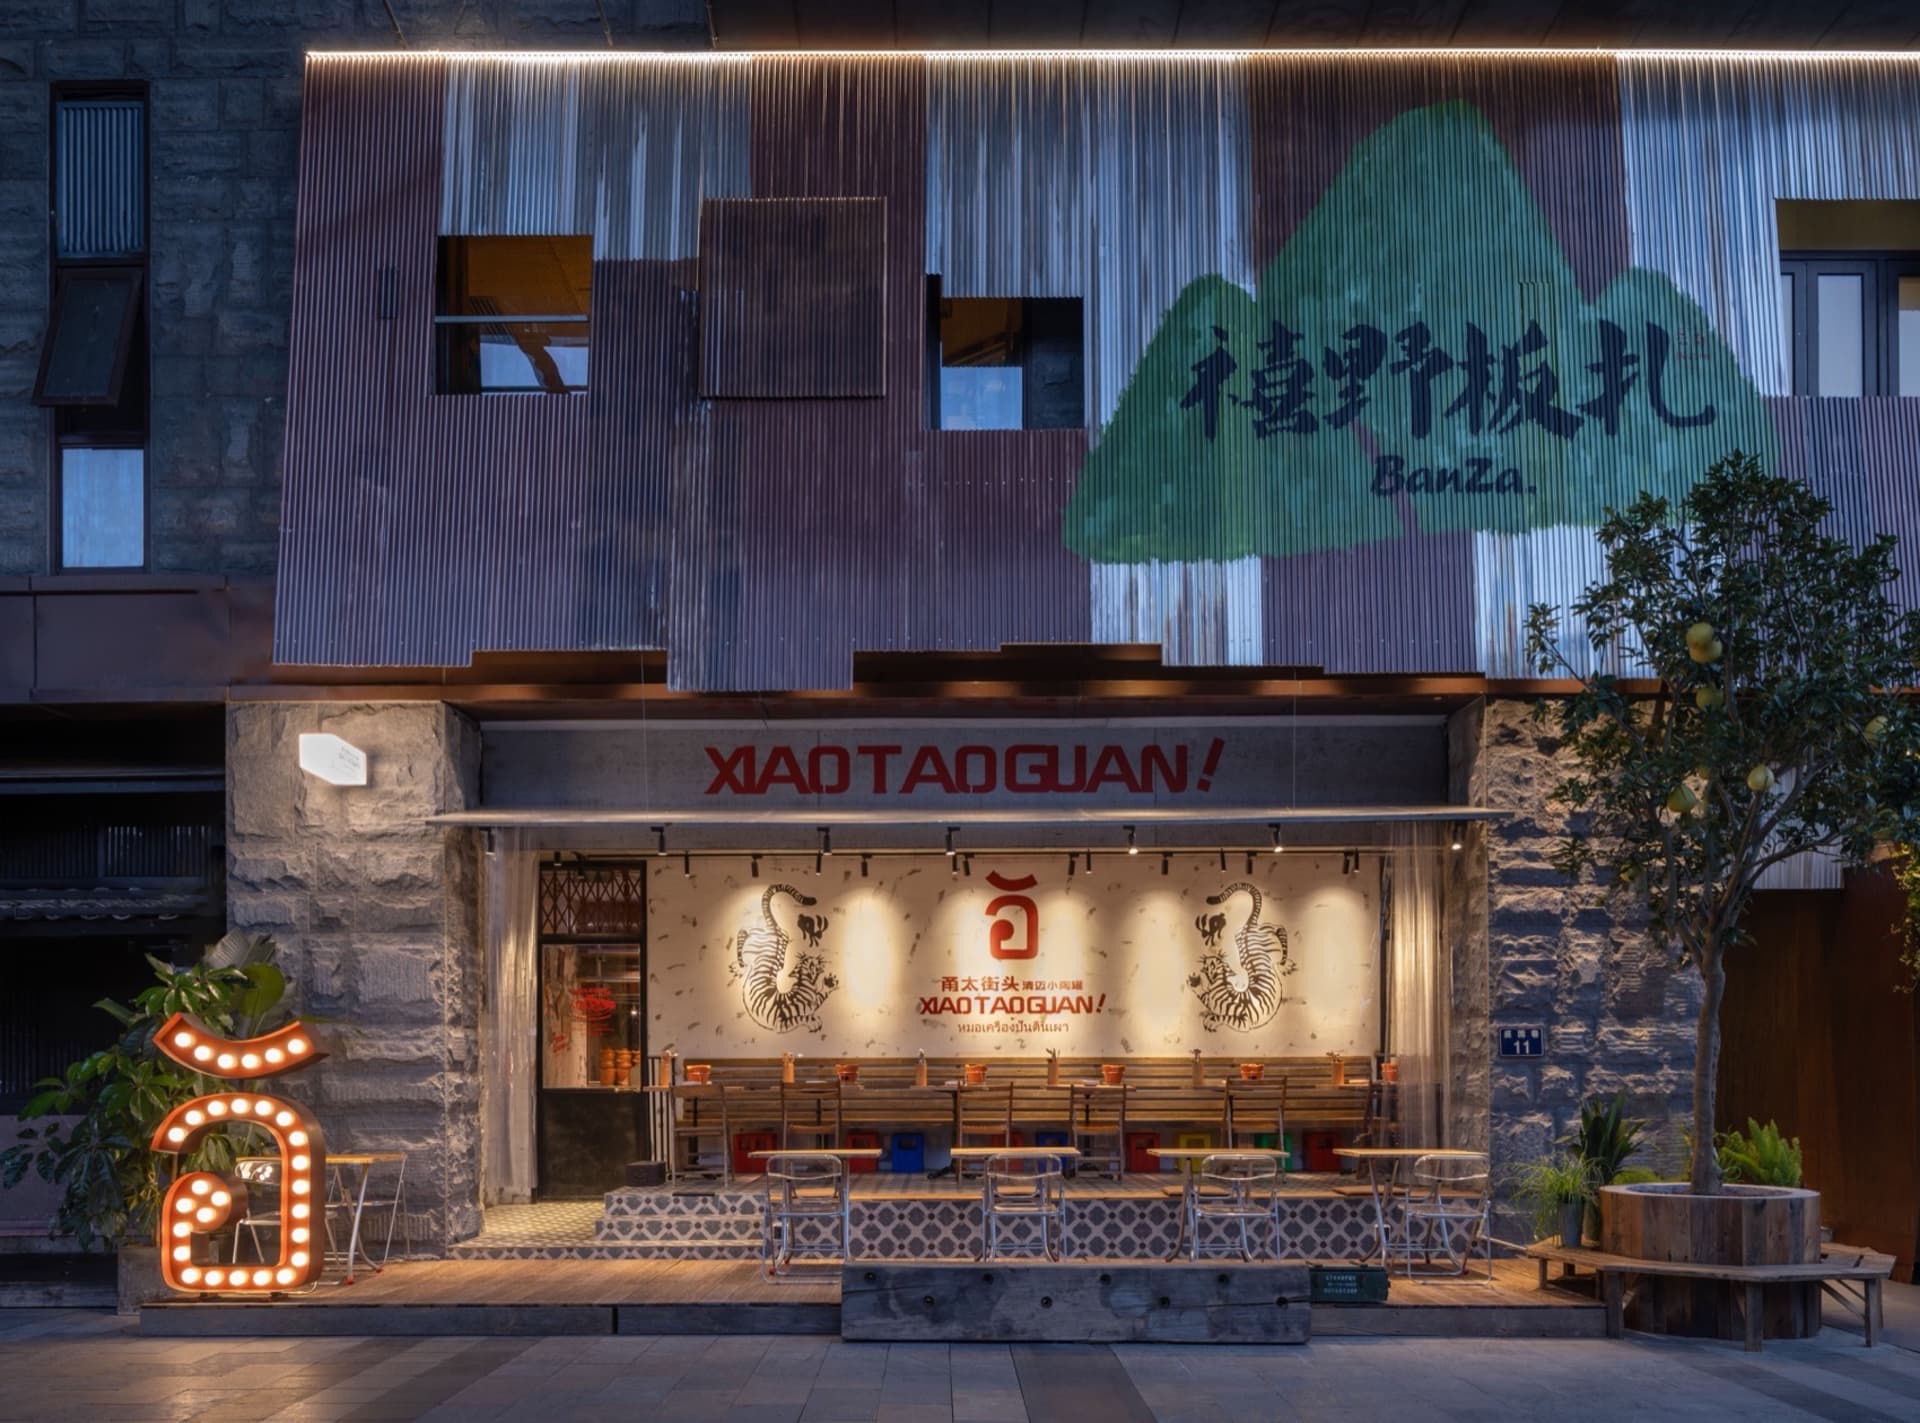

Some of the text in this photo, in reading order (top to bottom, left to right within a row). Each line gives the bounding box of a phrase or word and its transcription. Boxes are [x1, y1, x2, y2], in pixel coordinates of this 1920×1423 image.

[704, 737, 1224, 794] XIAOTAOGUAN!
[920, 993, 1106, 1015] XIAOTAOGUAN!
[1514, 1040, 1529, 1054] 11
